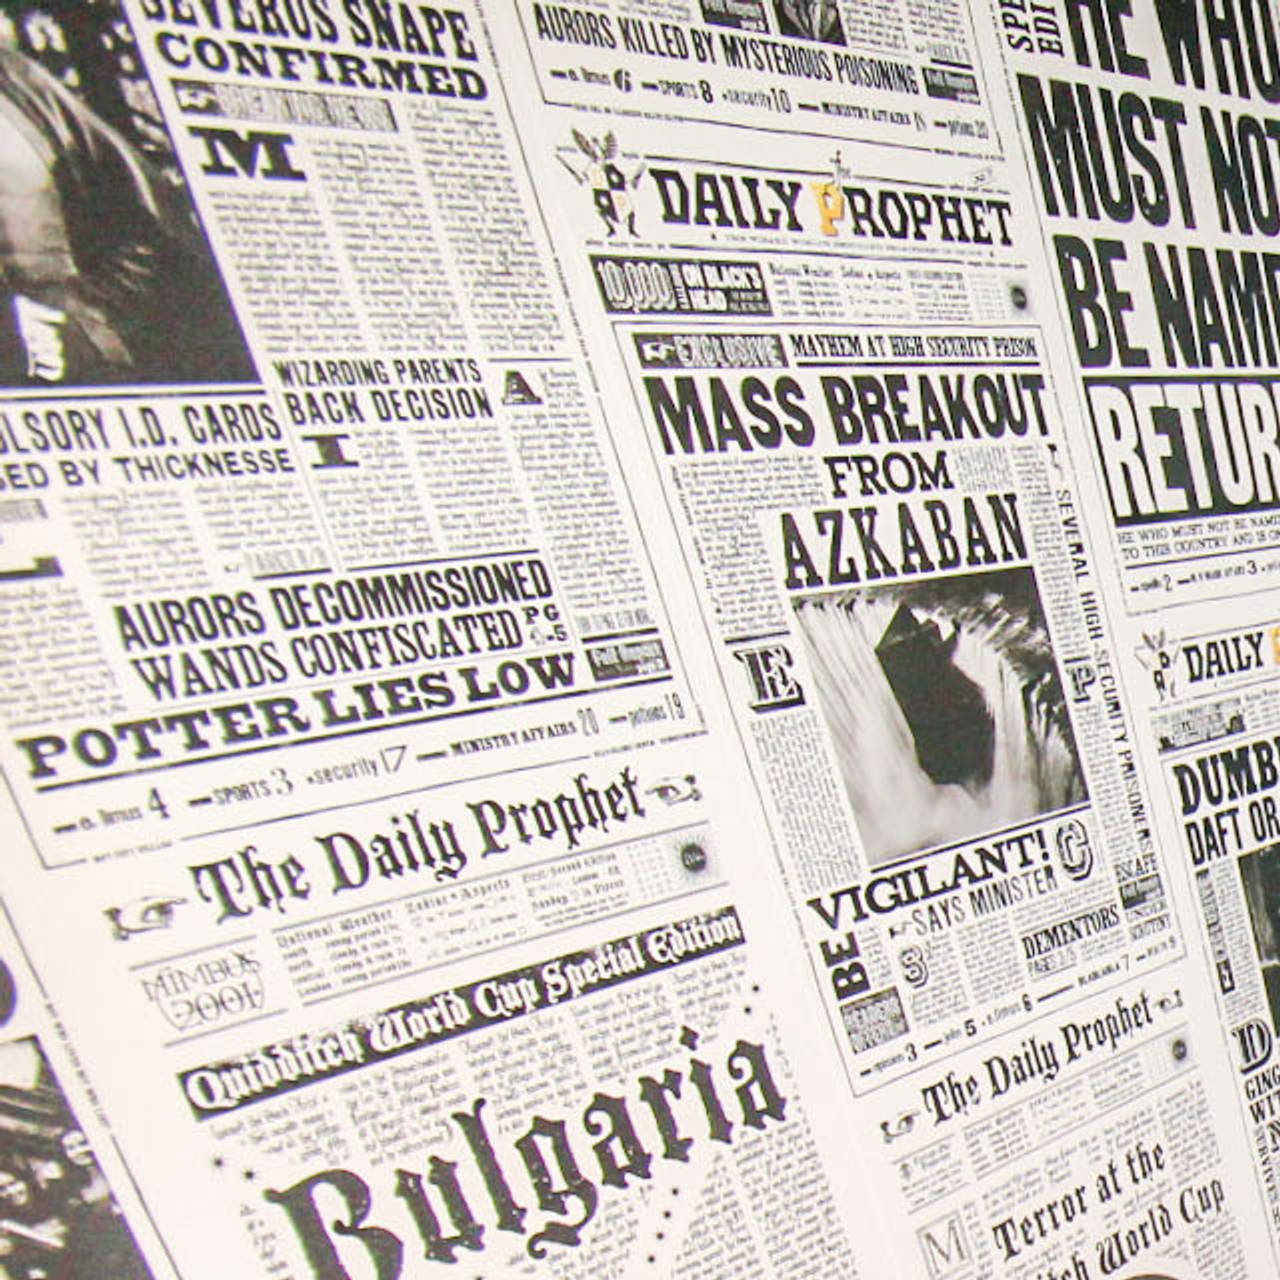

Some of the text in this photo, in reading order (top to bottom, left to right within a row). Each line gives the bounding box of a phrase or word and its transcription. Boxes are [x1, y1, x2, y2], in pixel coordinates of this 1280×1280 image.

[155, 31, 488, 100] CONFIRMED
[341, 0, 478, 61] SNAPE
[533, 3, 921, 96] AURORS KILLED BY MYSTERIOUS POISONING
[1016, 72, 1197, 231] MUST
[648, 168, 1013, 248] DAILY PROPHET
[1051, 233, 1152, 368] BE
[272, 358, 482, 387] WIZARDING PARENTS
[789, 334, 1038, 359] MAYHEM AT HIGH SECURITY PRISON
[118, 407, 178, 447] I.D.
[184, 403, 282, 444] CARDS
[285, 387, 495, 426] BACK DECISION
[642, 373, 1050, 455] MASS BREAKOUT
[61, 448, 296, 488] BY THICKNESSE
[823, 450, 955, 498] FROM
[780, 493, 1030, 590] AZKABAN
[113, 558, 554, 652] AURORS DECOMMISSIONED
[130, 642, 288, 702] WANDS
[290, 609, 524, 678] CONFISCATED
[1182, 630, 1264, 685] DAILY
[15, 651, 575, 779] POTTER LIES LOW
[188, 844, 312, 926] The
[314, 807, 468, 896] Daily
[465, 765, 647, 860] Prophet
[1184, 806, 1245, 866] DAFT
[1249, 796, 1280, 844] OR
[807, 828, 1051, 932] VIGILANT!
[910, 863, 1060, 938] SAYS MINISTER
[818, 930, 872, 1001] BE
[1020, 903, 1121, 961] DEMENTORS
[185, 910, 745, 1110] Quidditch World Cup Special Edition
[921, 992, 1155, 1129] The Daily Prophet
[992, 1140, 1167, 1264] Terror at the
[1097, 1201, 1176, 1276] World
[1179, 1176, 1227, 1226] Cup
